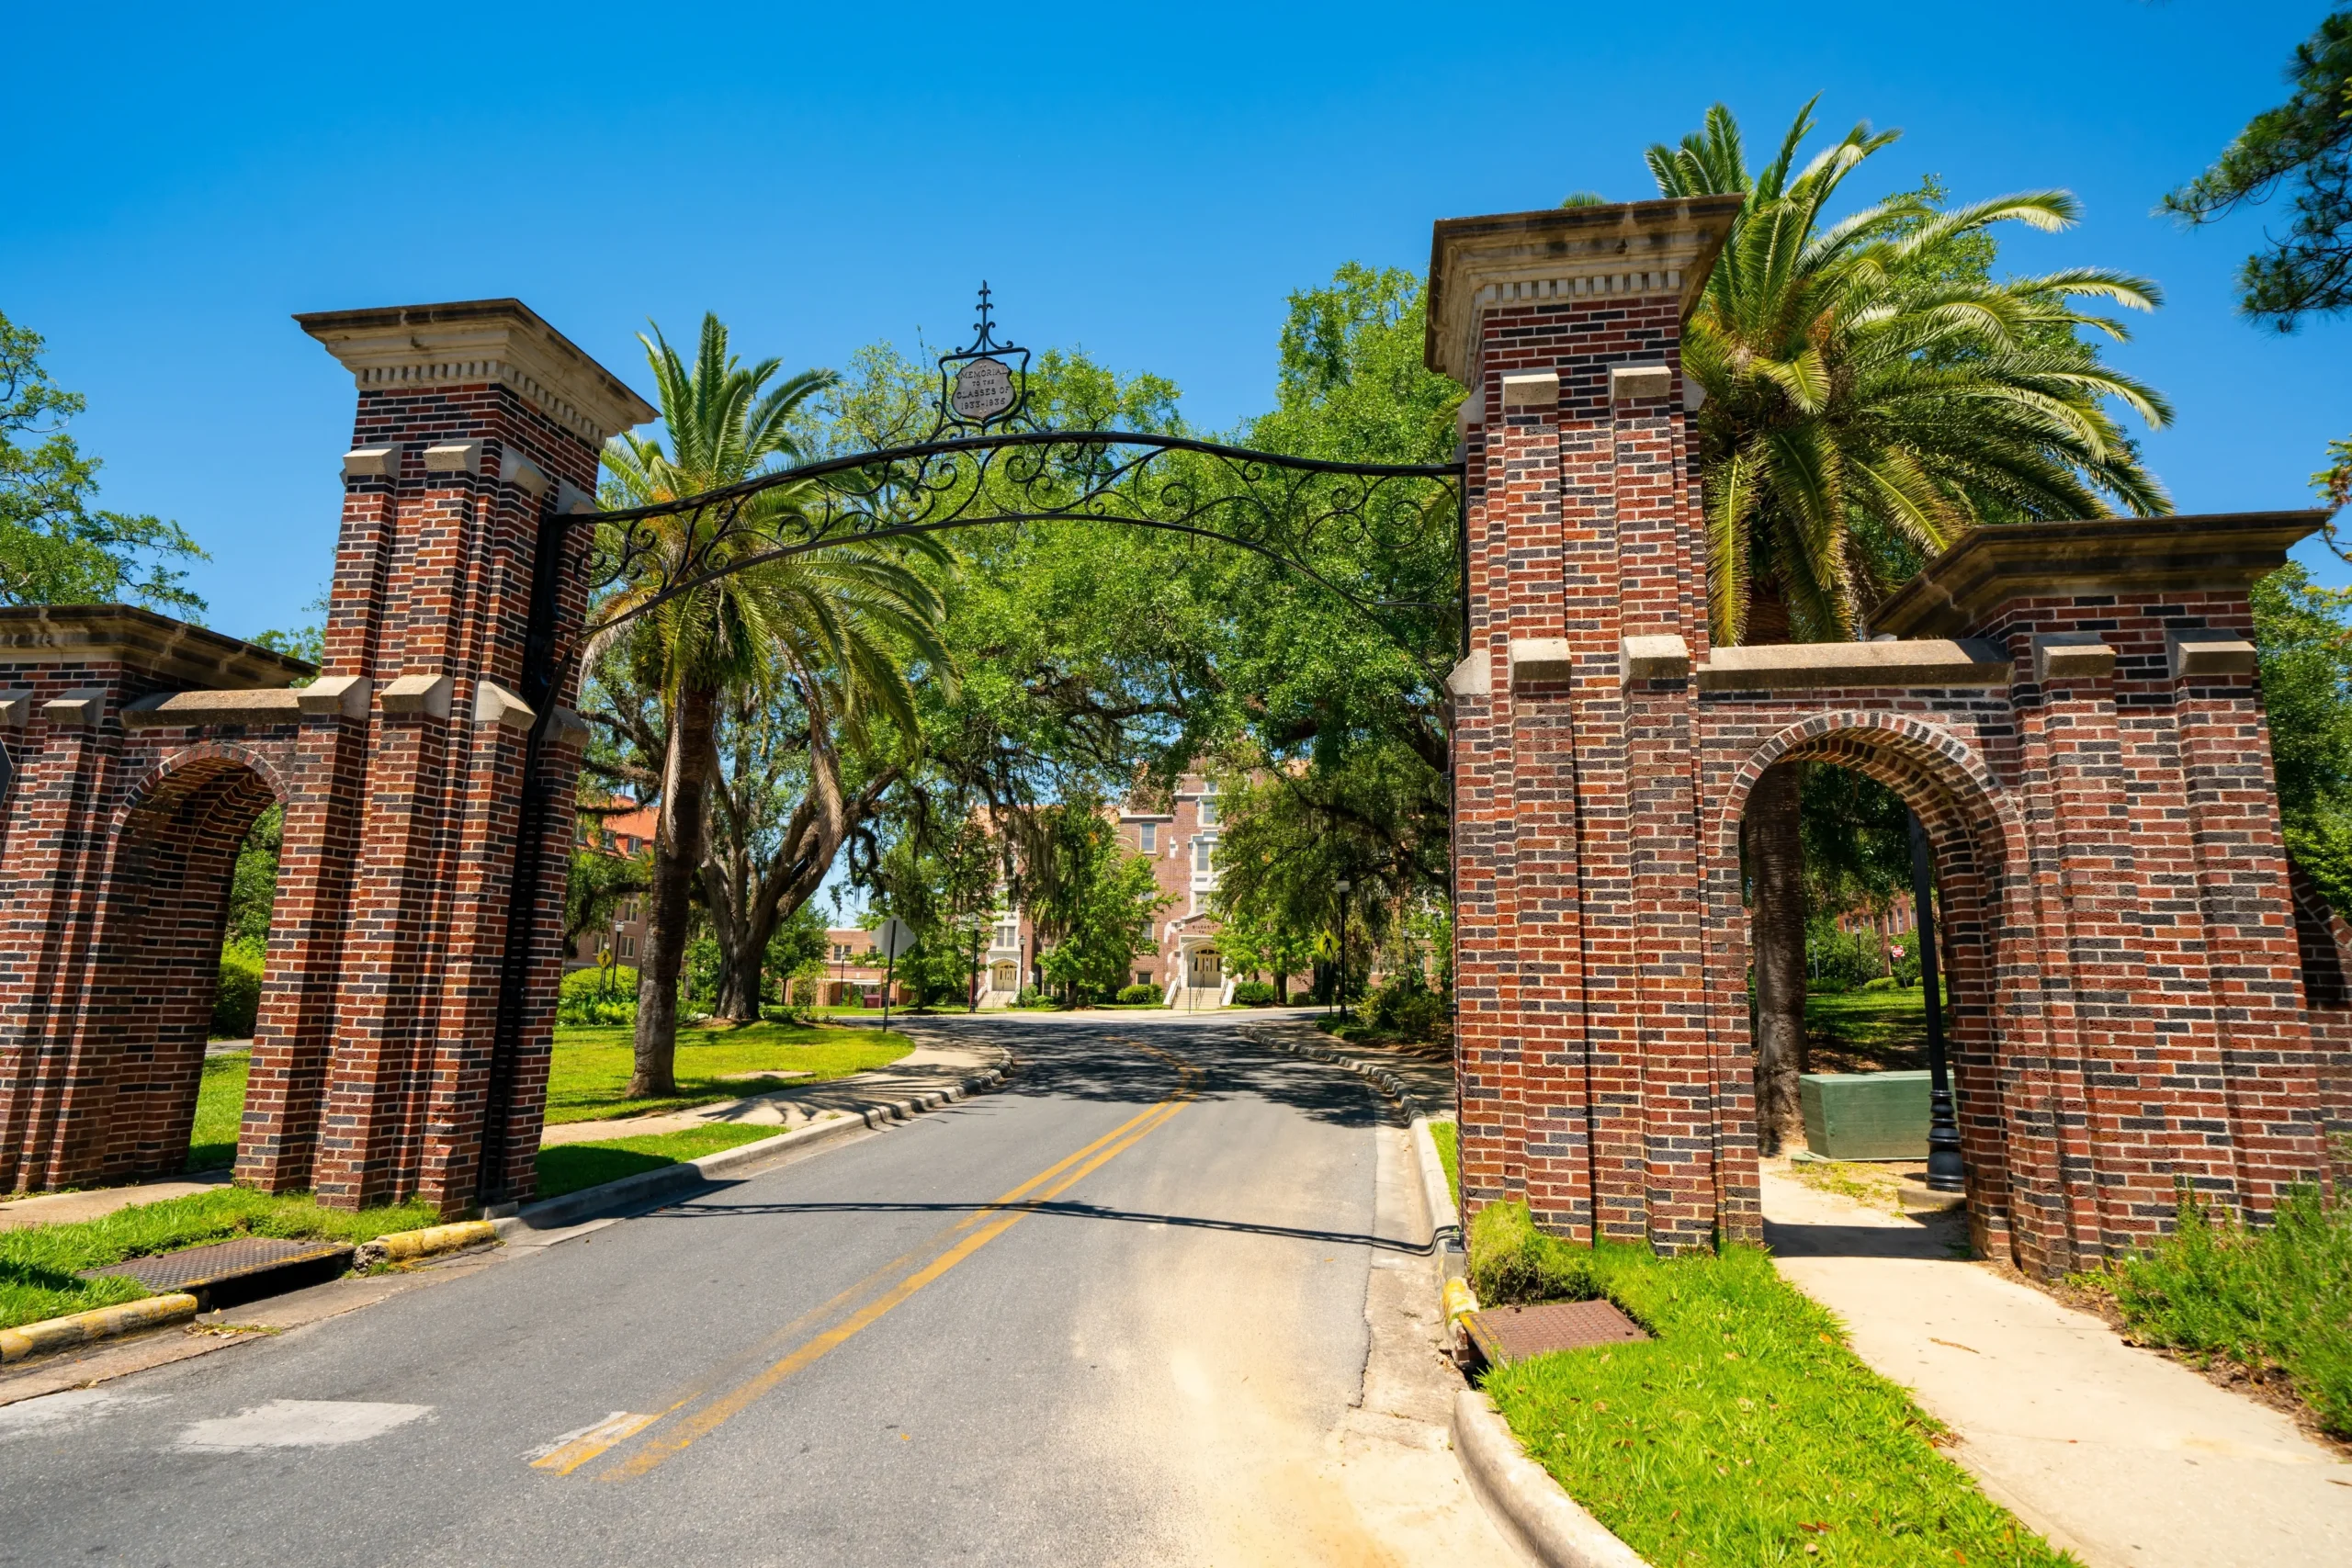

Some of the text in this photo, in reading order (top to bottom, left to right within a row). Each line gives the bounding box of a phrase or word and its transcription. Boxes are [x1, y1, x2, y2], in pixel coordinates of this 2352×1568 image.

[961, 368, 1008, 379] MEMORIAL
[956, 386, 1010, 400] CLASSES OF
